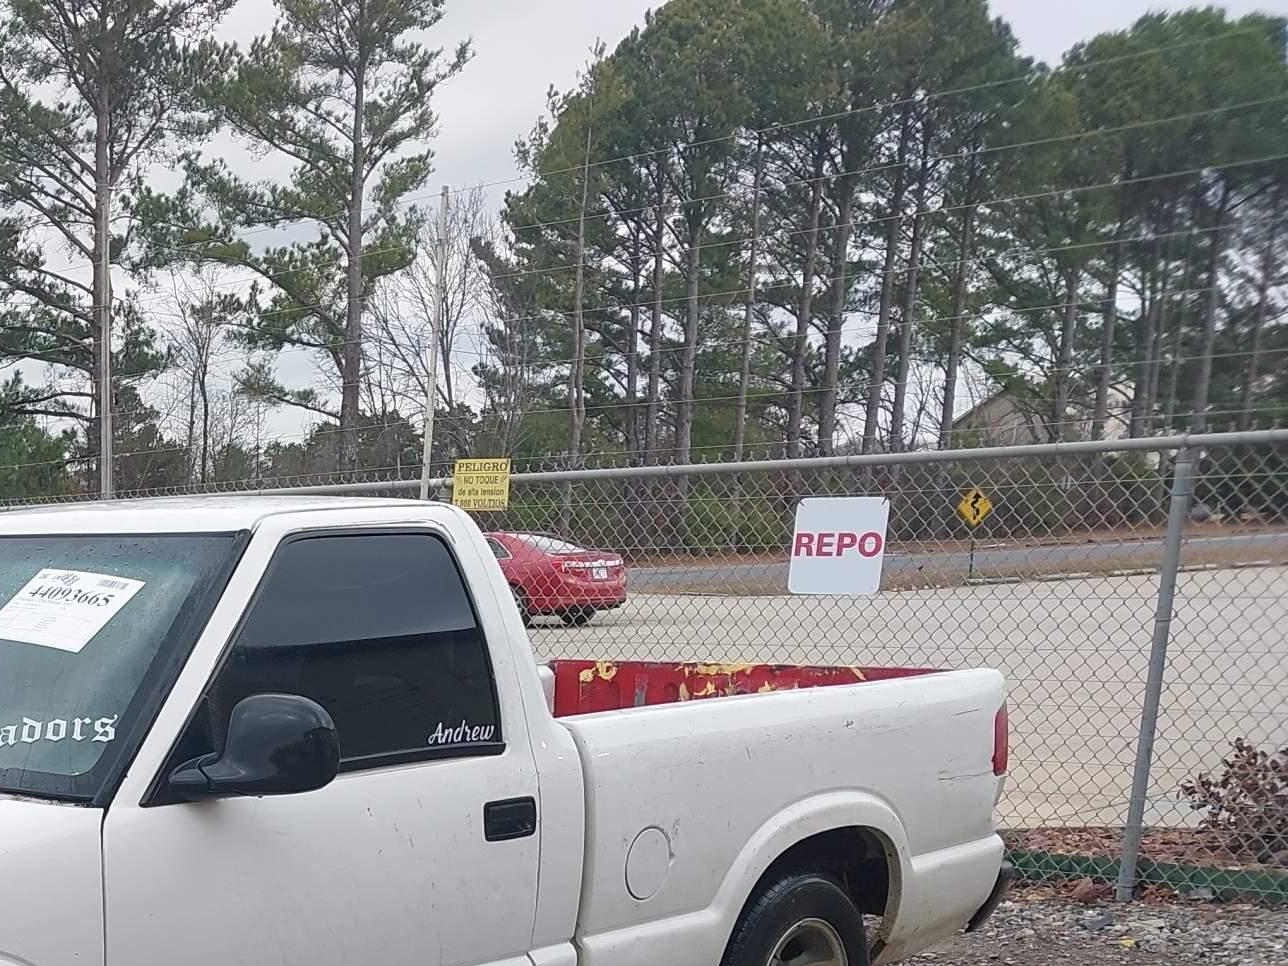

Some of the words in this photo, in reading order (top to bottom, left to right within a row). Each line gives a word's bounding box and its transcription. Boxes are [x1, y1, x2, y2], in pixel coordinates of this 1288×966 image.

[458, 462, 508, 472] PELIGRO
[463, 475, 474, 484] NO
[475, 475, 499, 484] TOQUE
[458, 487, 467, 496] de
[467, 487, 479, 496] alta
[472, 499, 505, 508] VOLTIOS
[793, 531, 884, 558] REPO
[28, 584, 116, 607] 44093665
[428, 719, 495, 745] Andrew
